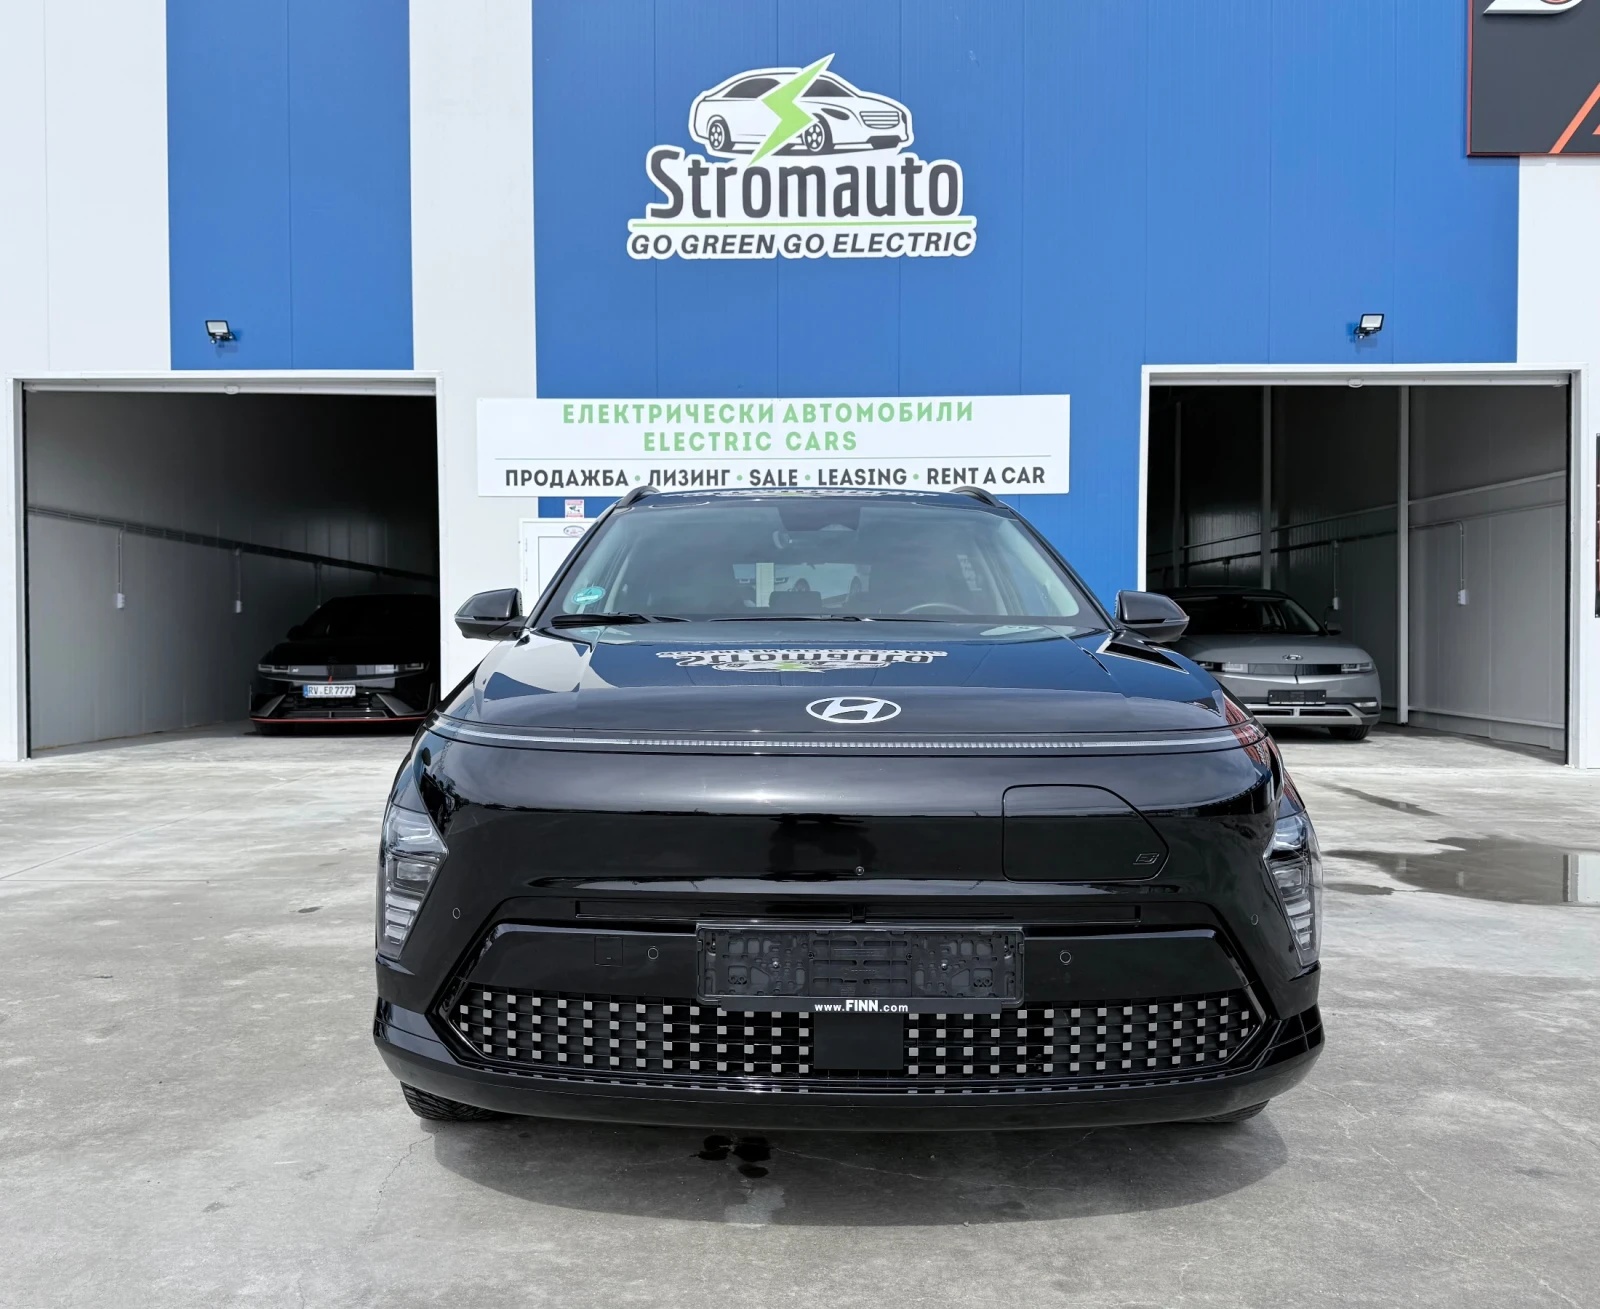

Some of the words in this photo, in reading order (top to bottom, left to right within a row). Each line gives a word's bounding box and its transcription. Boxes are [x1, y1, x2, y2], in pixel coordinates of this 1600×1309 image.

[650, 149, 959, 219] Stromauto
[631, 234, 672, 255] GO
[681, 234, 775, 255] GREEN
[783, 233, 825, 254] GO
[833, 231, 972, 254] ELECTRIC
[563, 403, 774, 424] ЕЛЕКТРИЧЕСКИ
[783, 401, 973, 423] АВТОМОБИЛИ
[644, 432, 772, 451] ELECTRIC
[785, 431, 857, 451] CARS
[505, 469, 629, 488] ПРОДАЖБА
[647, 469, 731, 487] ЛИЗИНГ
[749, 469, 798, 486] SALE
[818, 468, 907, 486] LEASING
[927, 467, 979, 485] RENT
[983, 467, 997, 484] A
[1001, 466, 1045, 484] CAR
[814, 999, 909, 1013] www.FINN.com
